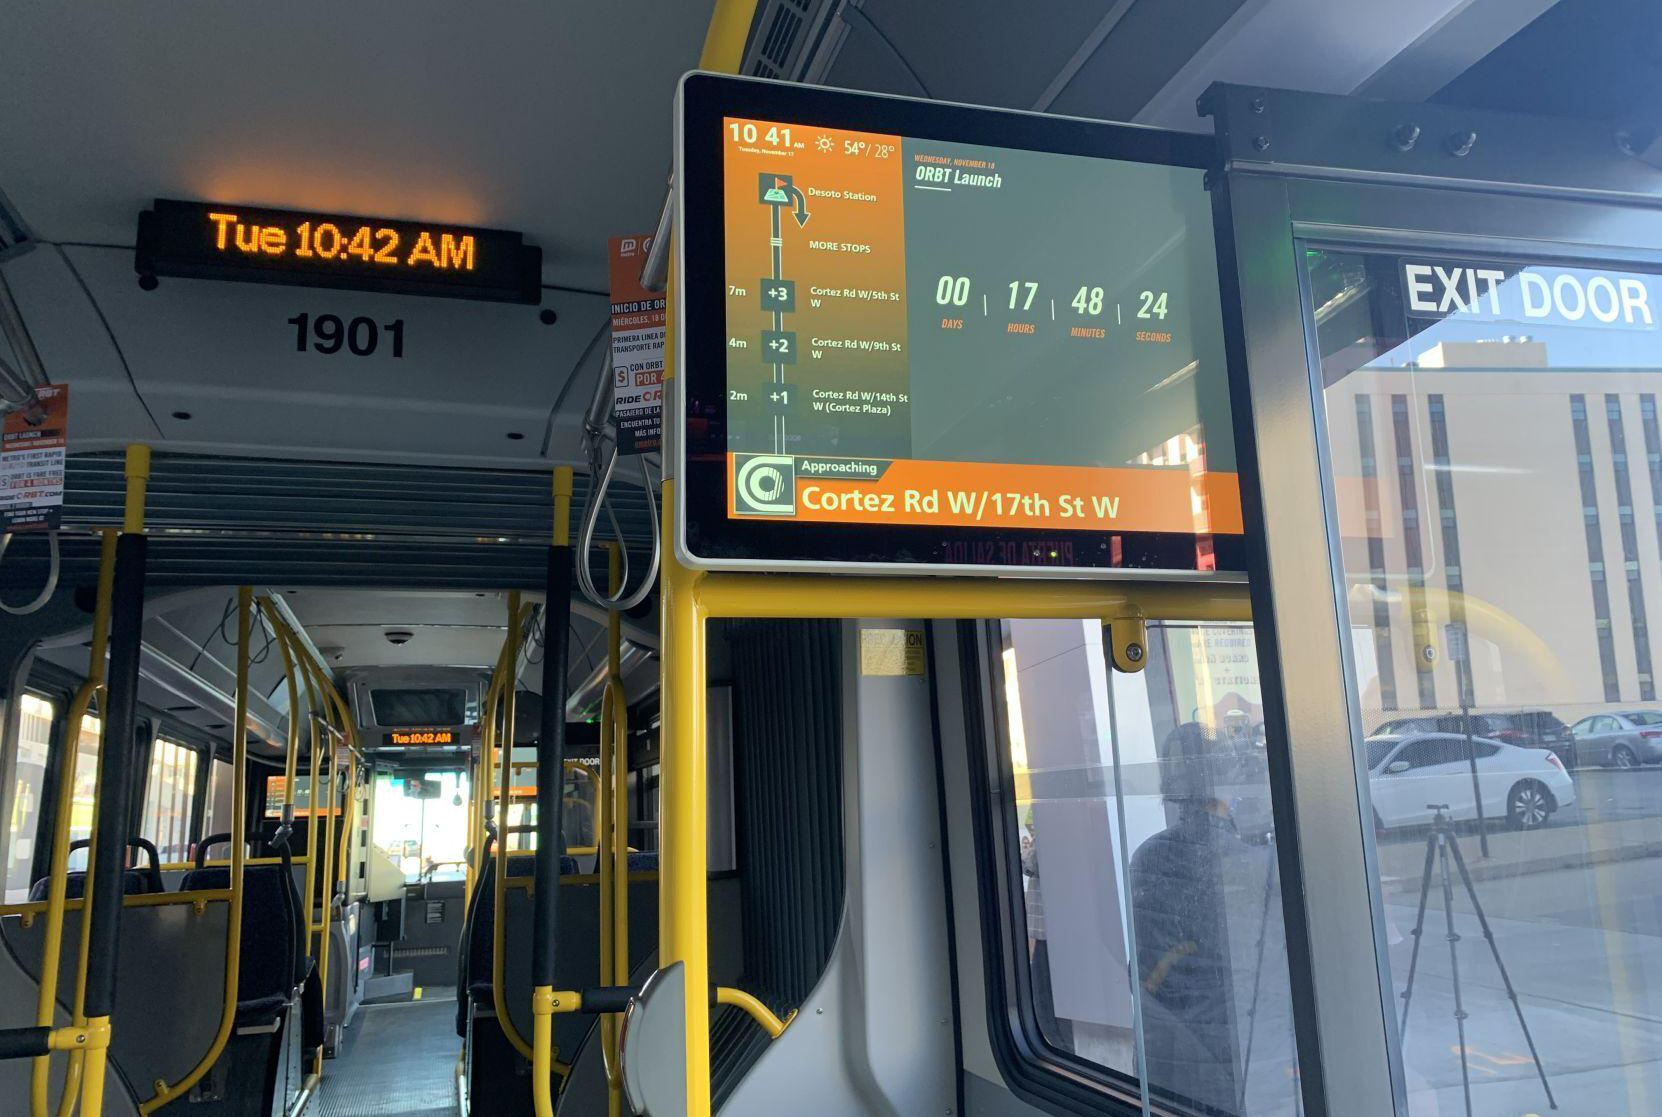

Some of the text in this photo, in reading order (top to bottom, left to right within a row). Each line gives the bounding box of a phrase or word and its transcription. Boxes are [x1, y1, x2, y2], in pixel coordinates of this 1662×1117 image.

[729, 122, 757, 144] 10
[765, 126, 790, 146] 41
[914, 154, 952, 166] WEDNESDAY,
[954, 158, 986, 168] NOVEMBER
[916, 166, 1002, 188] ORBT Launch
[808, 187, 877, 203] Desoto Station
[209, 213, 474, 270] Tue 10:42 AM
[809, 240, 872, 254] MORE STOPS
[729, 286, 746, 296] 7m
[768, 287, 788, 301] +3
[810, 286, 900, 300] Cortez Rd W/5th St
[936, 275, 1168, 320] 00 17 48 24
[1406, 264, 1653, 324] EXIT DOOR
[612, 300, 665, 314] INICIO DE OR
[810, 299, 821, 308] W
[612, 315, 650, 326] MIÉRCOLES,
[288, 312, 404, 358] 1901
[941, 318, 1172, 342] DAYS HOURS MINUTES SECONDS
[612, 334, 640, 344] PRIMERA
[642, 332, 658, 342] LINEA
[729, 338, 747, 348] 4m
[768, 338, 788, 352] +2
[812, 338, 902, 352] Cortez Rd W/9th St
[614, 342, 664, 354] TRANSPORTE RAP
[812, 350, 822, 359] W
[630, 360, 663, 372] CON ORBT
[636, 374, 656, 386] POR
[730, 390, 748, 401] 2m
[770, 391, 788, 404] +1
[812, 390, 909, 403] Cortez Rd W/14th St
[644, 407, 652, 415] DE
[813, 402, 891, 416] W (Cortez Plaza)
[620, 420, 652, 428] ENCUENTRA
[634, 428, 647, 437] MÁS
[801, 460, 878, 476] Approaching
[801, 486, 1120, 520] Cortez Rd W/17th St W
[392, 733, 452, 744] Tue 10:42 AM
